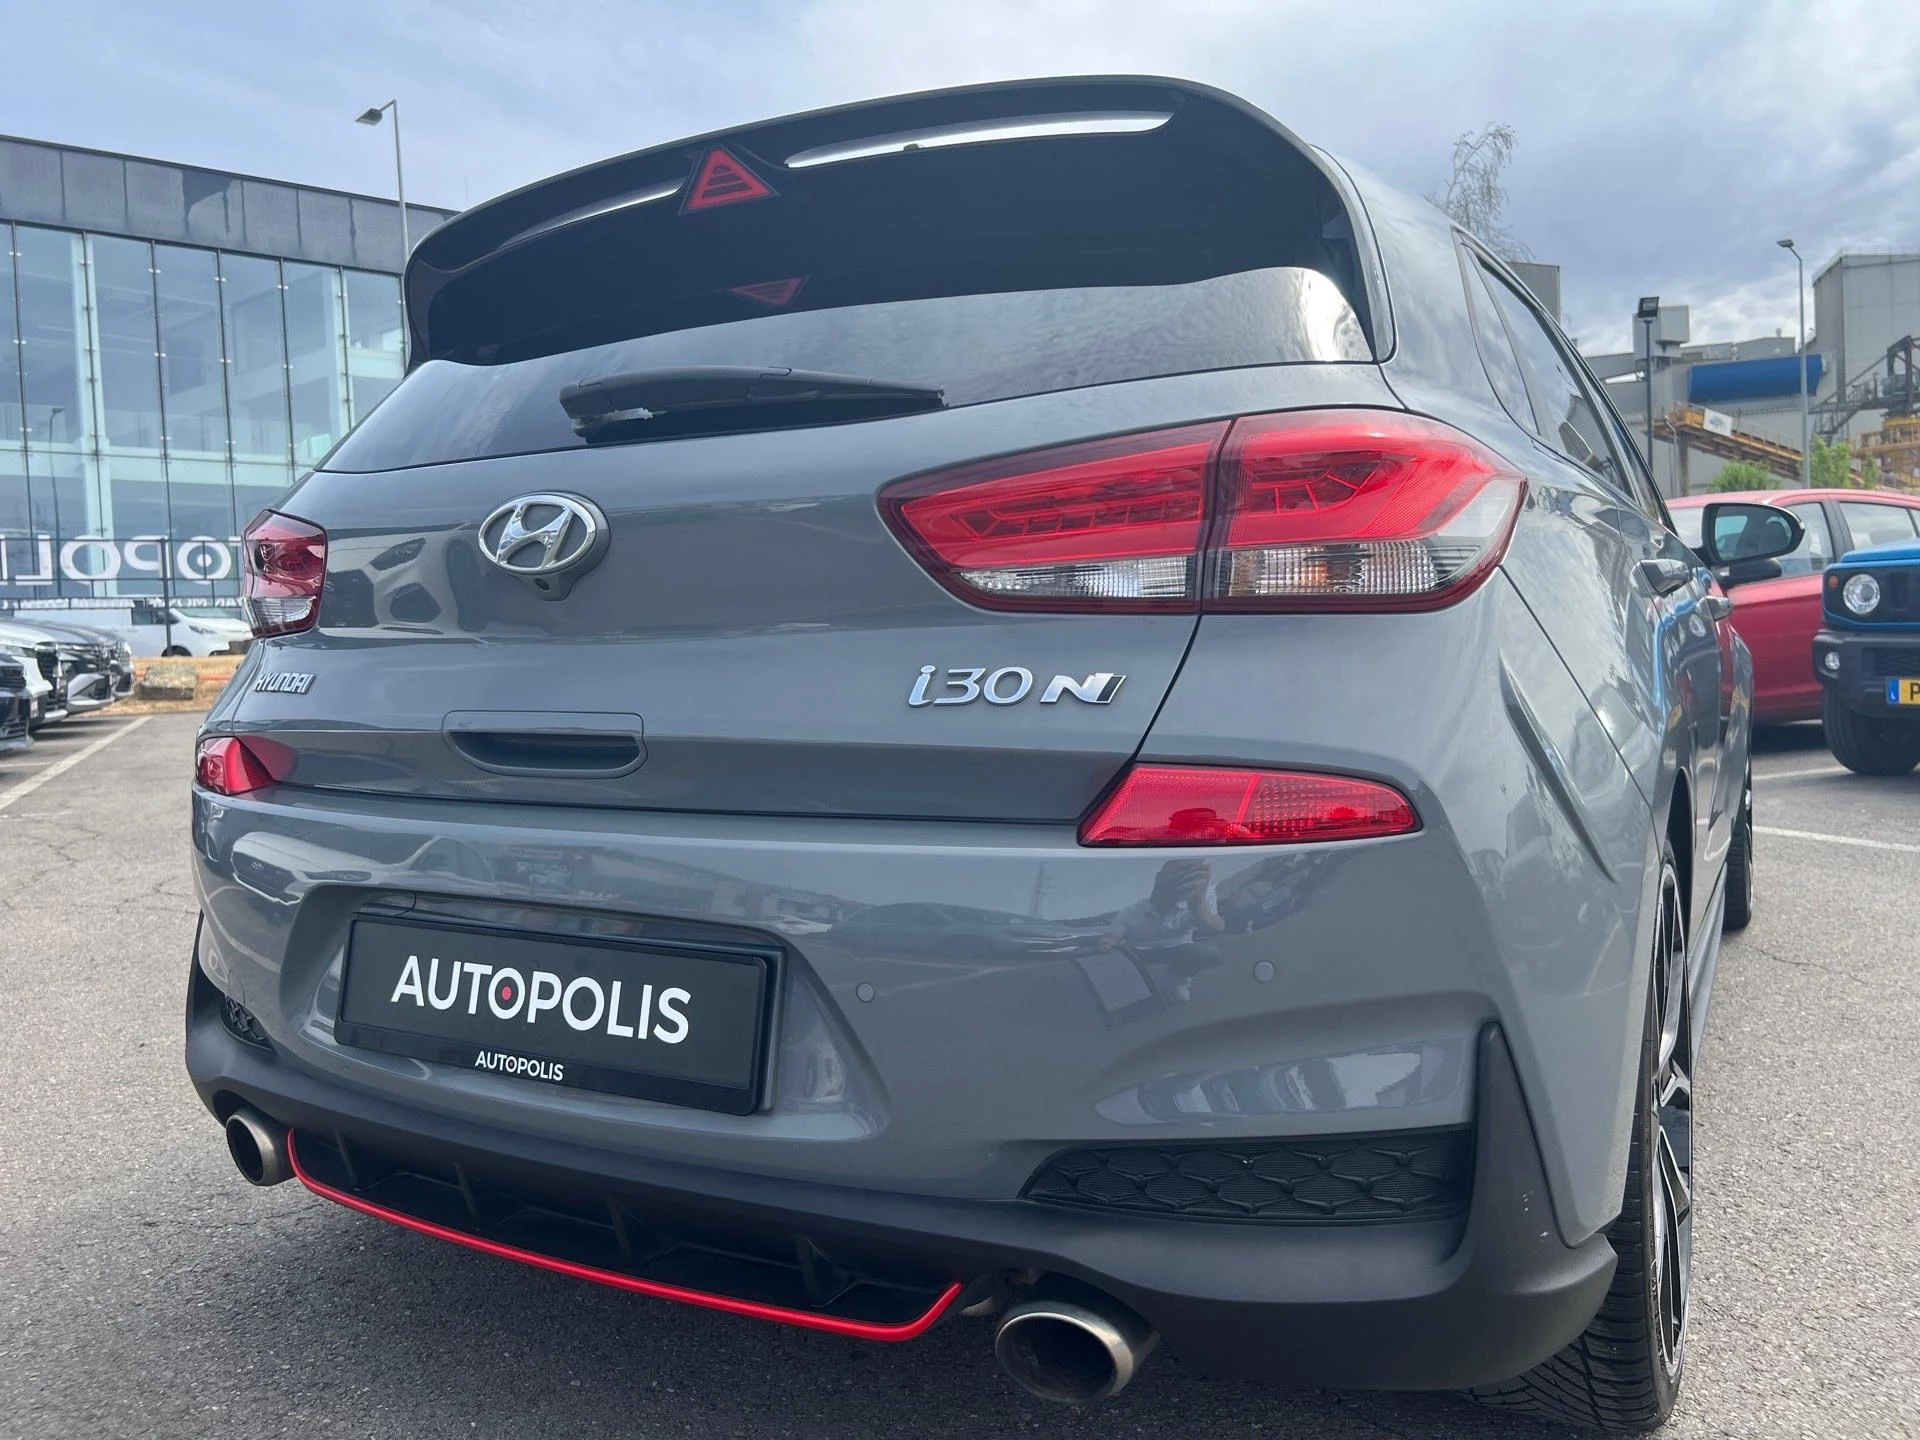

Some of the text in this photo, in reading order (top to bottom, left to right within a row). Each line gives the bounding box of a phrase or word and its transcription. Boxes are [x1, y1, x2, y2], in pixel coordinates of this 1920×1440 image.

[254, 672, 314, 693] HYUNDAI
[908, 665, 1127, 707] i30 N
[390, 954, 692, 1045] AUTOPOLIS
[475, 1050, 564, 1081] AUTOPOLIS
